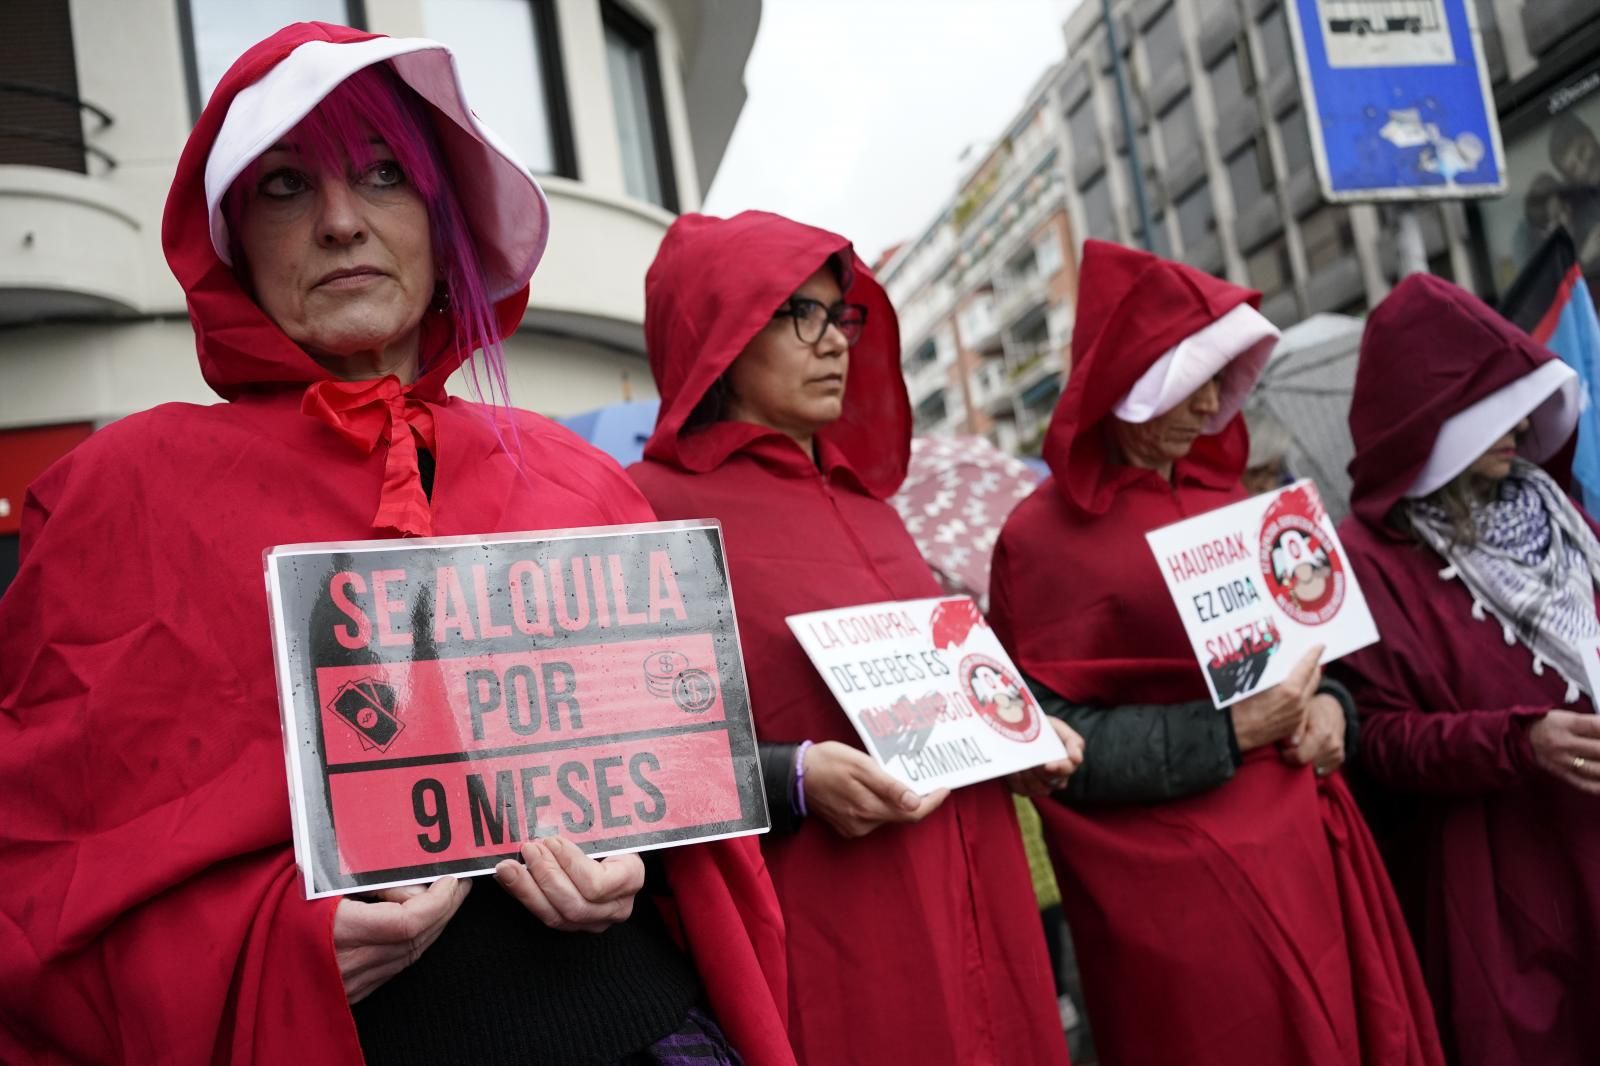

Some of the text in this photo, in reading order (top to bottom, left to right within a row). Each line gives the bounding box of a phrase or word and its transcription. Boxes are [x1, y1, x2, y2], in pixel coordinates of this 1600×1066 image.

[1166, 532, 1252, 583] HAURRAK
[329, 550, 688, 650] SE ALQUILA
[1192, 576, 1261, 624] EZ DIRA
[808, 611, 920, 650] LA COMPRA
[830, 650, 951, 693] DE BEBÉS ES
[465, 661, 584, 741] POR
[899, 736, 992, 782] CRIMINAL
[411, 752, 667, 854] 9 MESES
